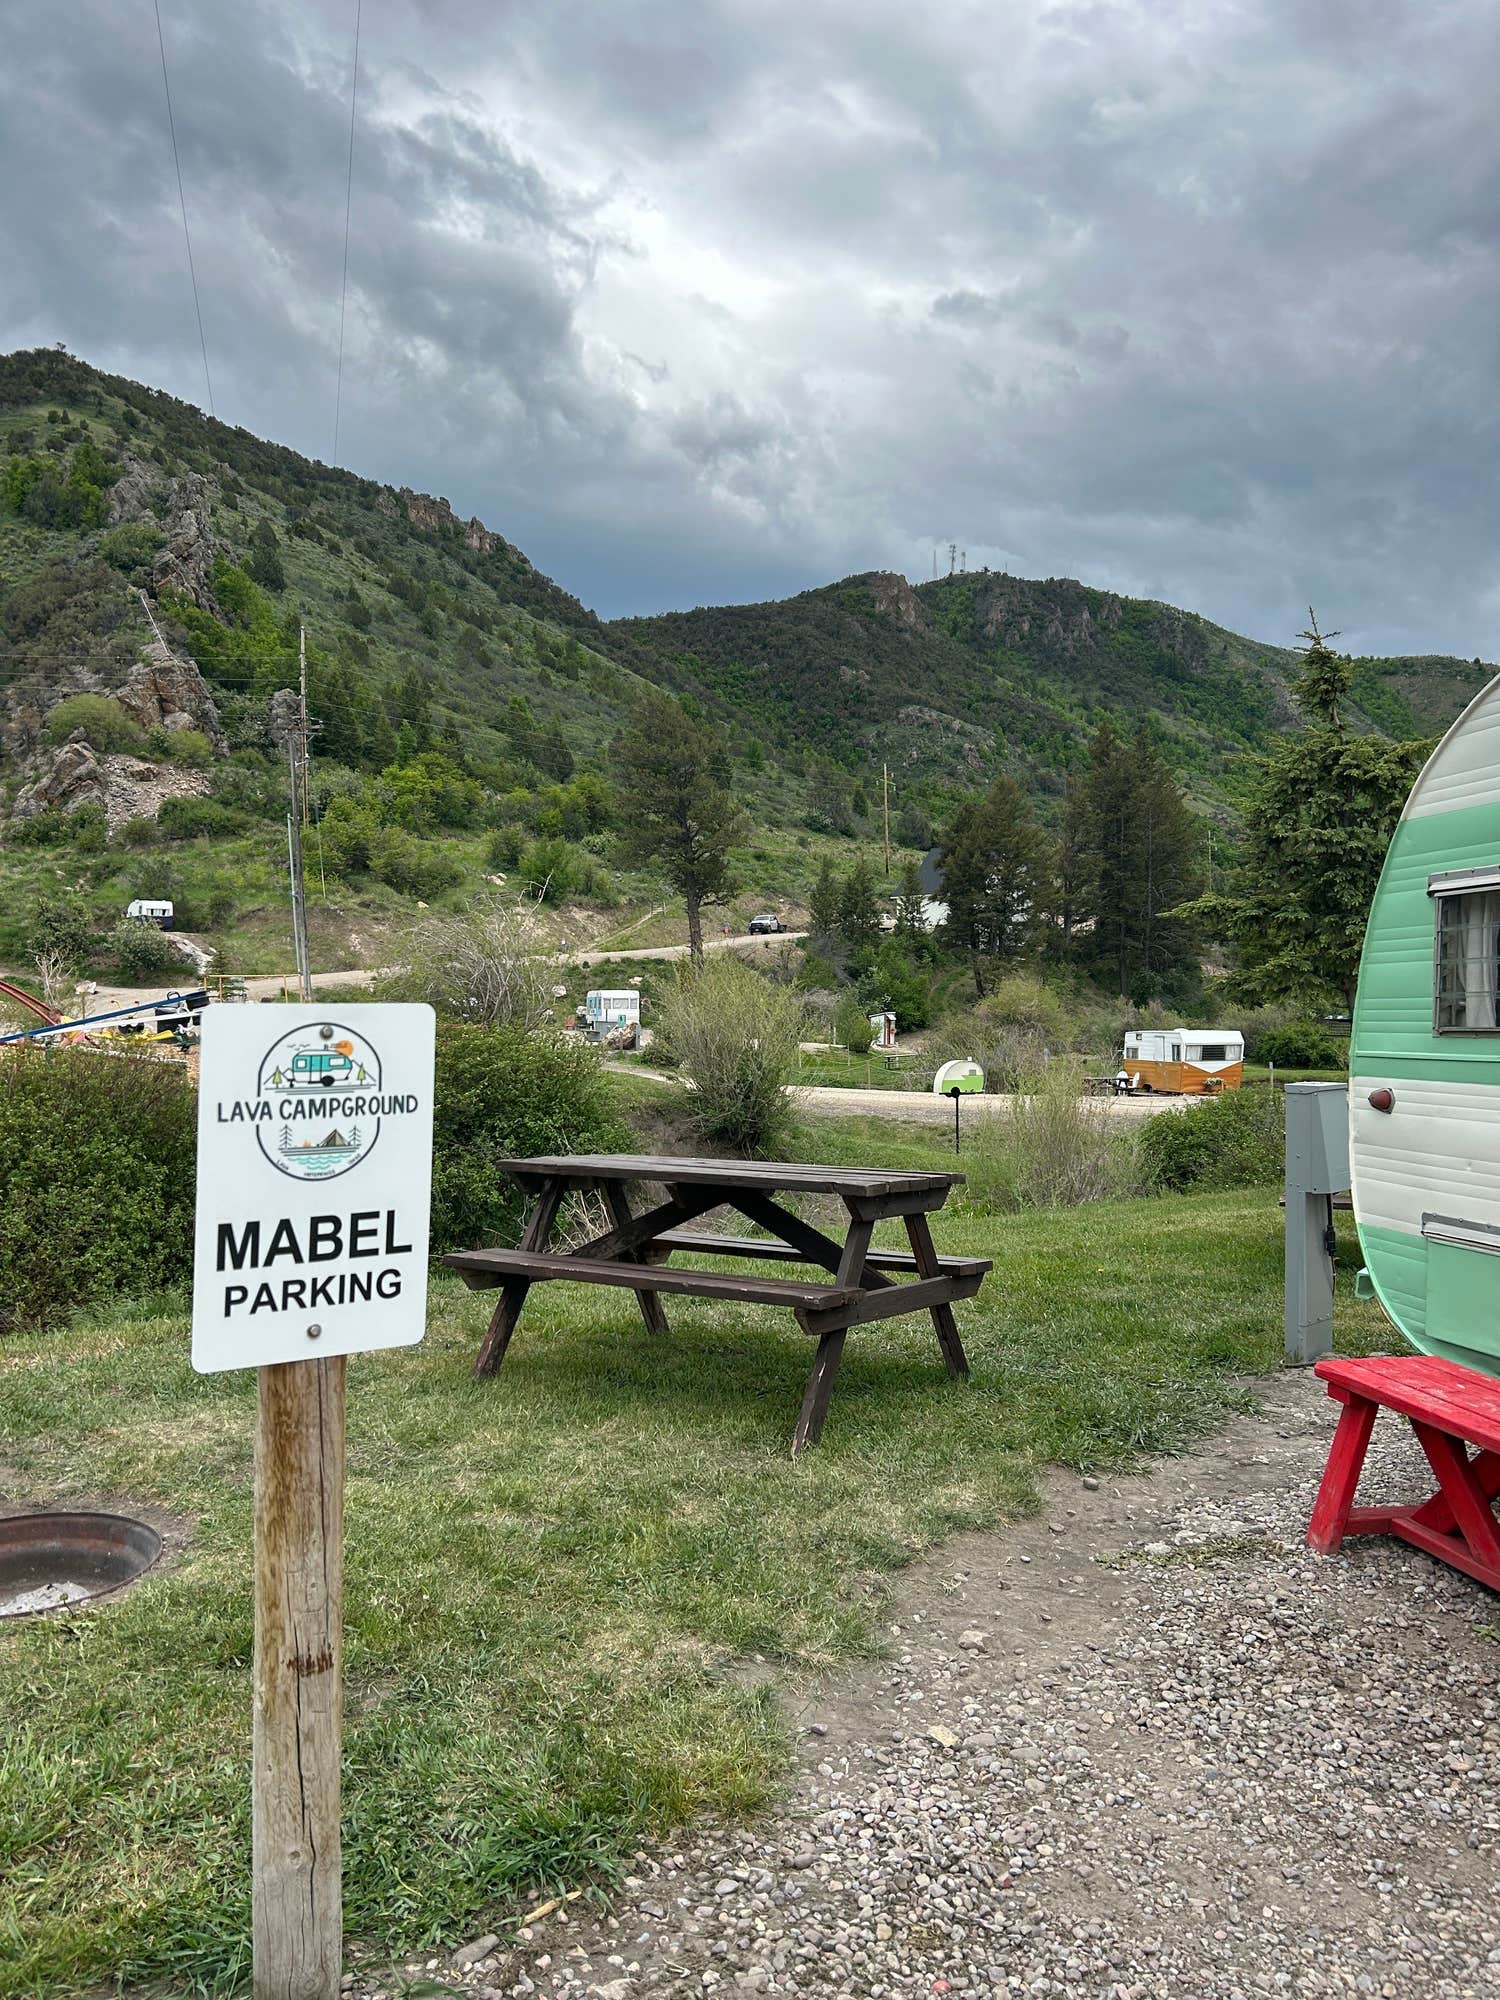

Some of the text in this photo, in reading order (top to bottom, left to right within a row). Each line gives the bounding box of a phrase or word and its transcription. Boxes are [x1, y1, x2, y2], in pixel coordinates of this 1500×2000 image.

[217, 1094, 419, 1123] LAVA CAMPGROUND
[216, 1210, 413, 1272] MABEL
[224, 1269, 402, 1318] PARKING
